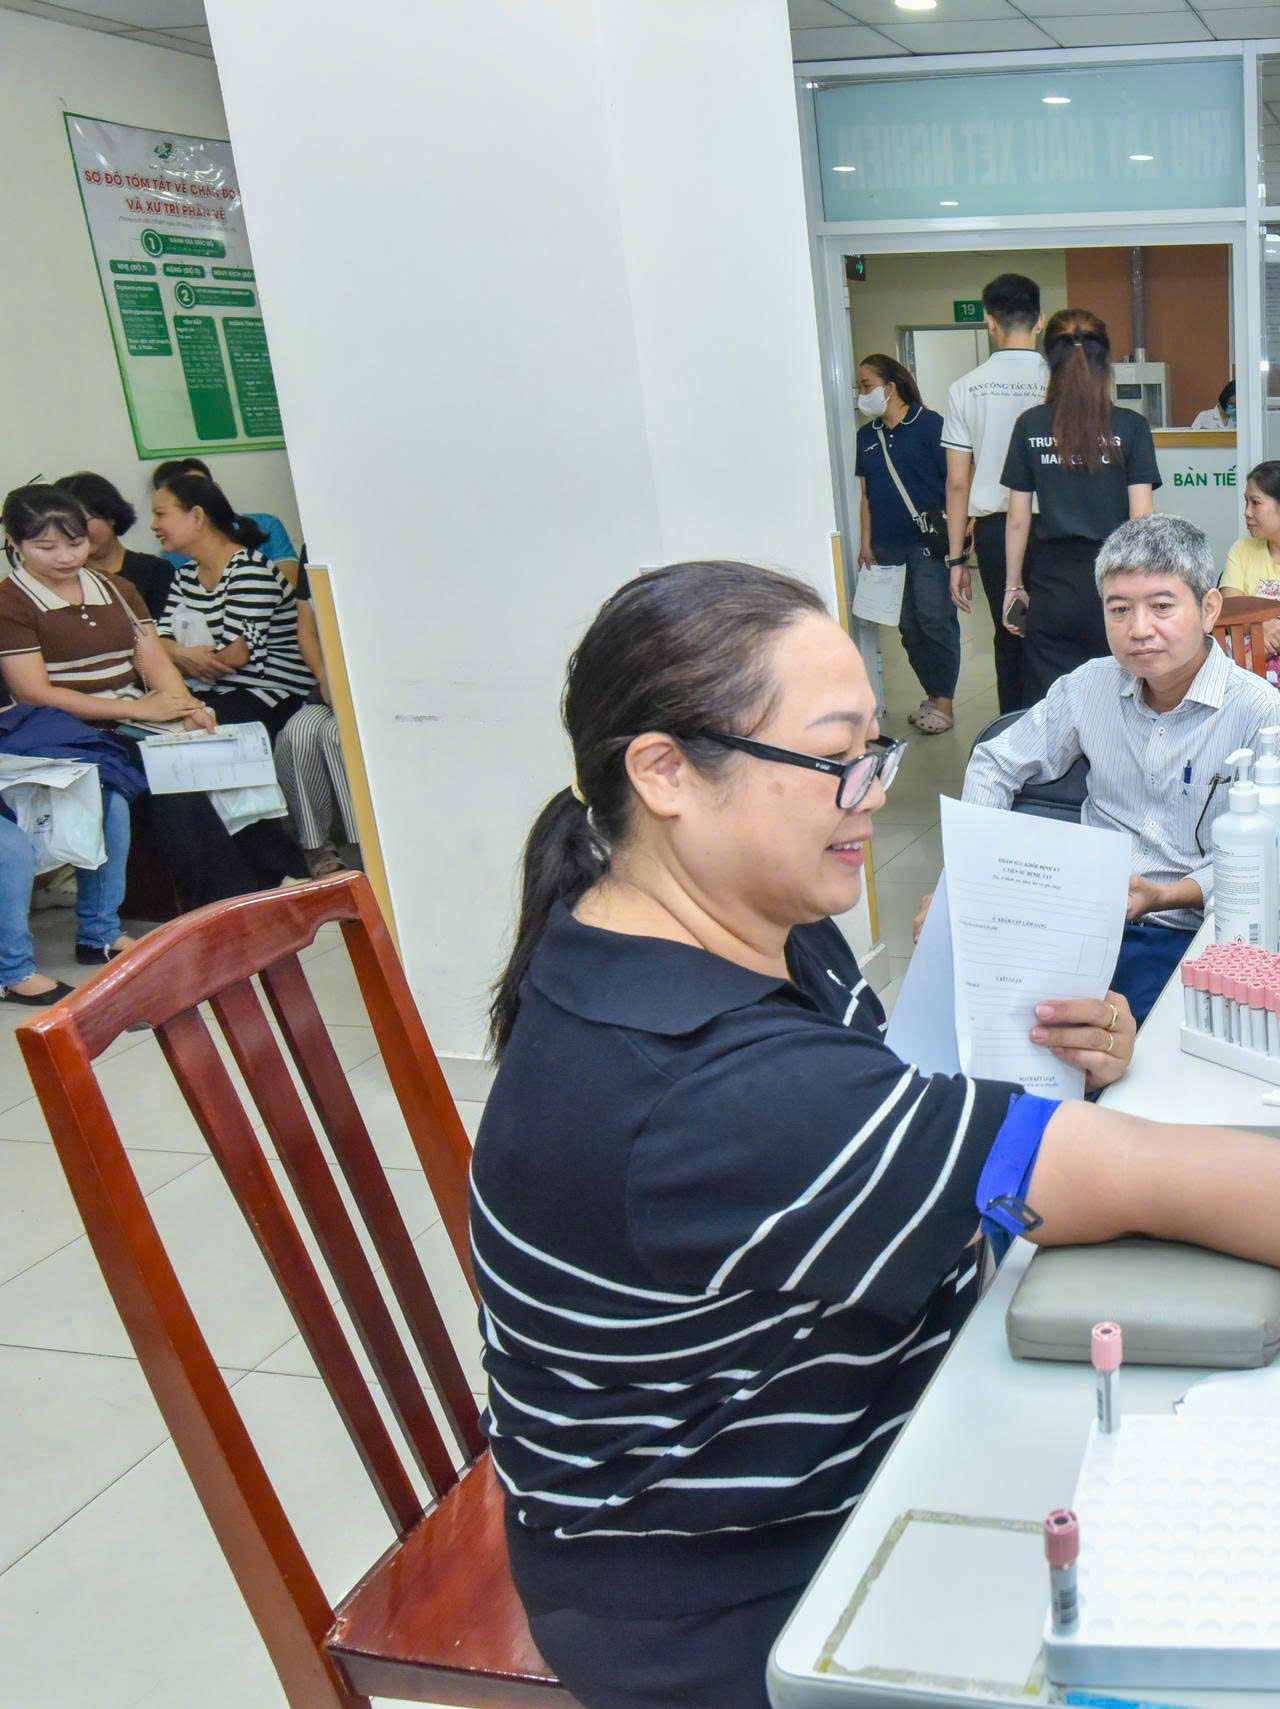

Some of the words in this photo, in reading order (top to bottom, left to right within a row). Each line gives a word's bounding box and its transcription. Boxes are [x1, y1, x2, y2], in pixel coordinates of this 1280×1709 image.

[182, 290, 190, 301] 2
[961, 303, 976, 316] 19
[1174, 466, 1207, 487] BÀN
